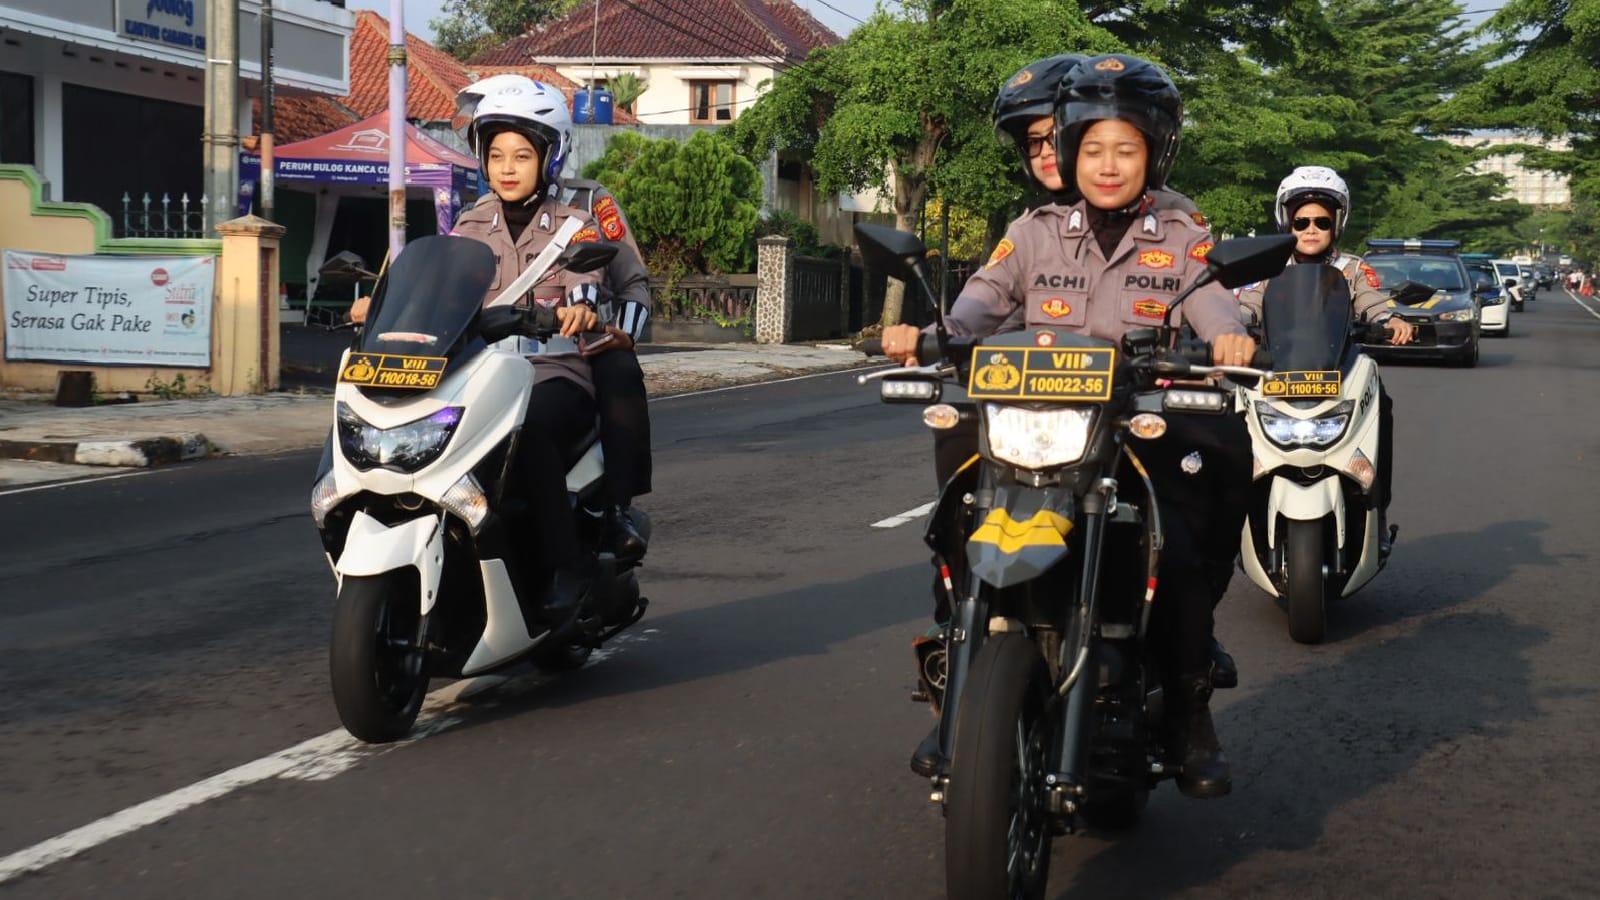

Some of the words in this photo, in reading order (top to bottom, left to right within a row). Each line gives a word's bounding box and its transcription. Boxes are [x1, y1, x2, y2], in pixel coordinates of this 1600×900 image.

[280, 161, 311, 172] PERUM
[313, 162, 342, 173] BULOG
[345, 164, 376, 174] KANCA
[1034, 274, 1086, 289] ACHI
[1125, 275, 1181, 292] POLRI
[26, 284, 78, 308] Super
[84, 286, 133, 310] Tipis,
[10, 310, 65, 330] Serasa
[71, 313, 105, 332] Gak
[110, 314, 152, 333] Pake
[402, 358, 428, 370] VIII
[1052, 352, 1088, 369] VIII
[379, 371, 437, 386] 110018-56
[1029, 376, 1104, 393] 100022-56
[1290, 382, 1338, 395] 110016-56
